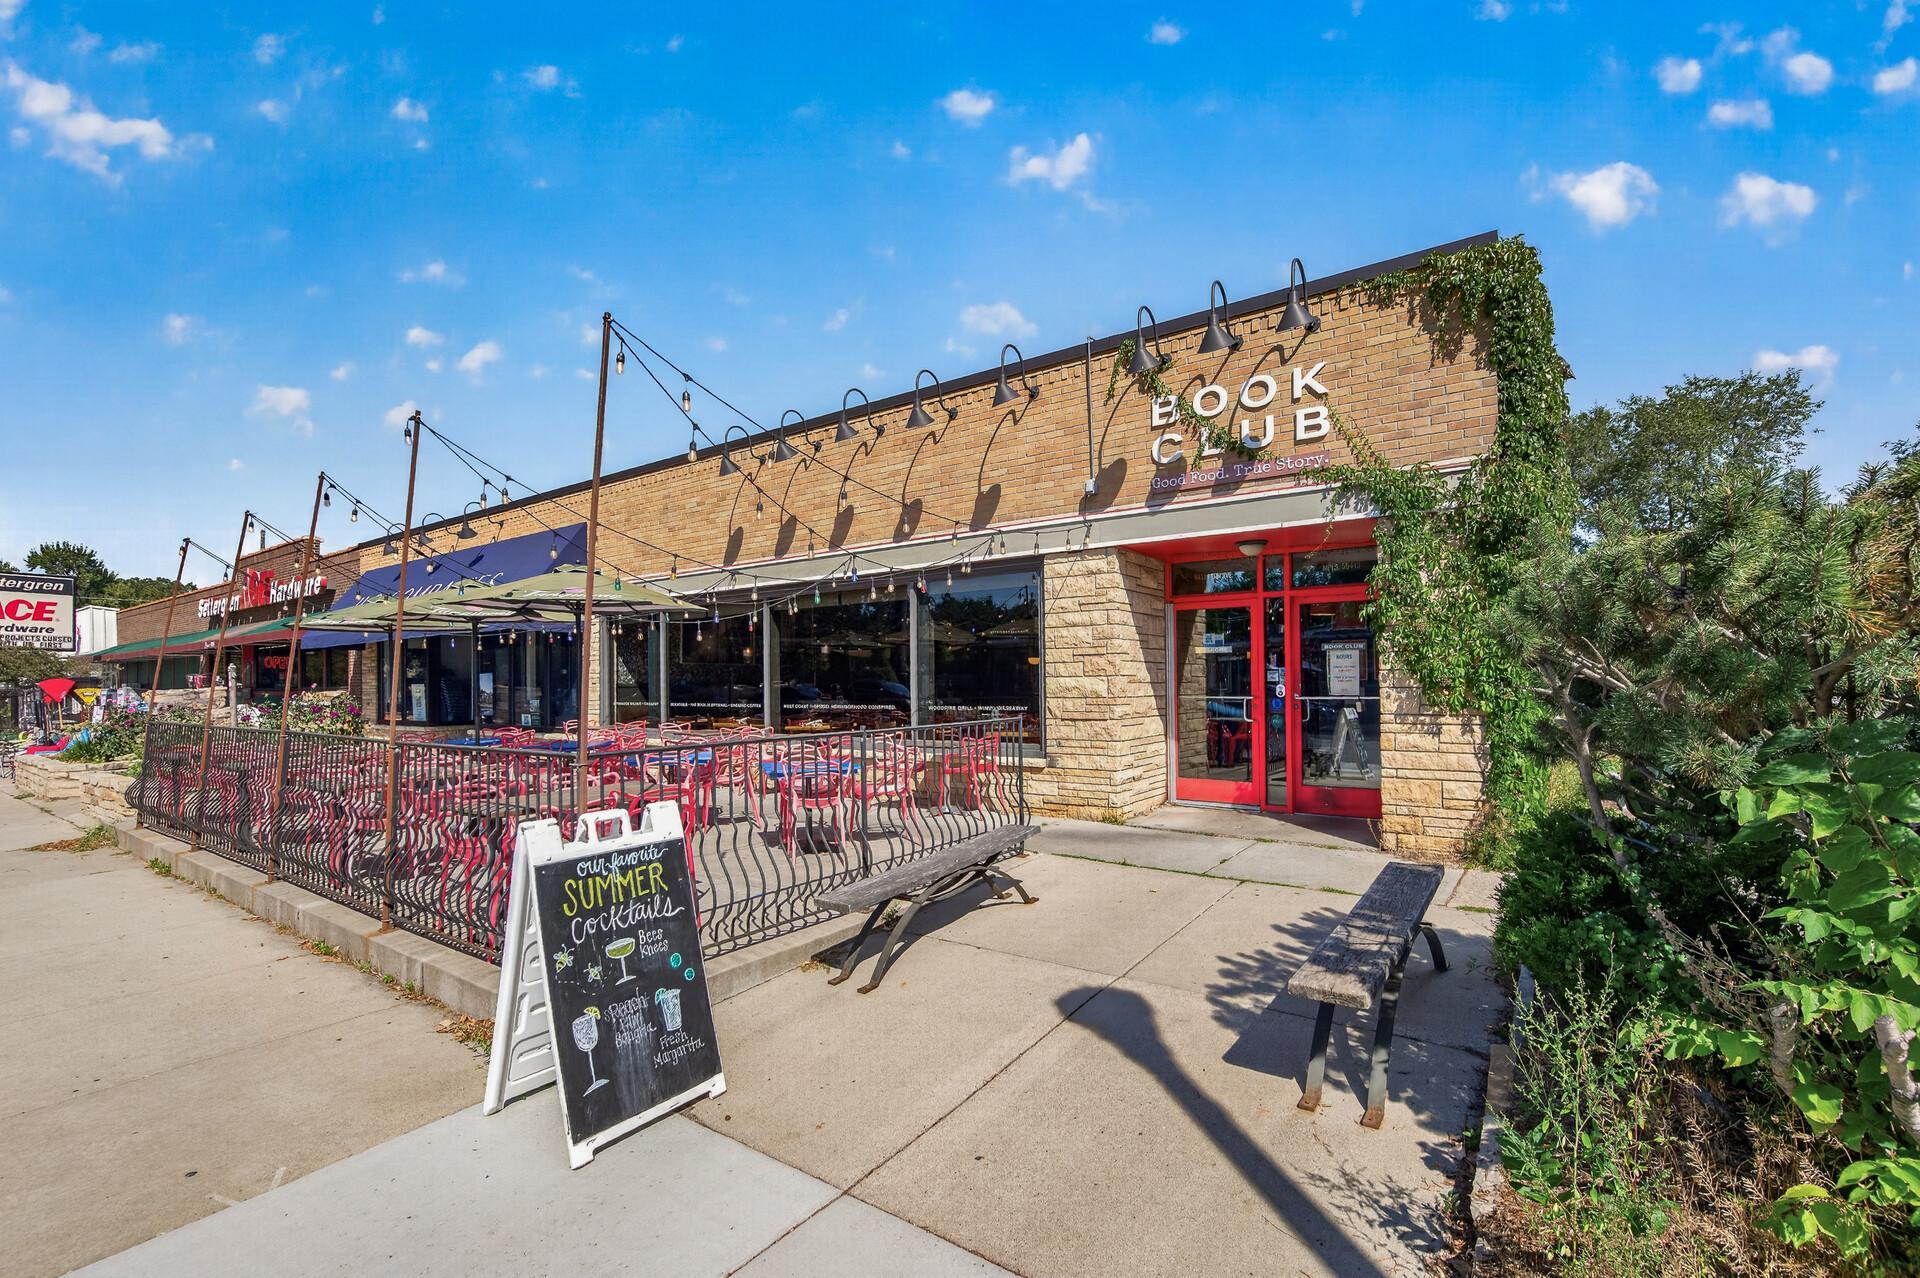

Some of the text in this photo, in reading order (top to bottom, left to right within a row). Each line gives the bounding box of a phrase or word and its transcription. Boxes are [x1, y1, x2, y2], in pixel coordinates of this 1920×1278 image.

[1151, 361, 1330, 428] BOOK
[1151, 405, 1331, 464] CLUB
[1152, 453, 1330, 489] Good Food. True Story.
[0, 598, 58, 622] CE
[264, 656, 291, 670] OPE
[577, 845, 669, 883] our favorite
[563, 862, 669, 917] SUMMER
[638, 928, 664, 944] Bees
[653, 1036, 705, 1068] Margarita
[660, 1029, 689, 1050] Fresh
